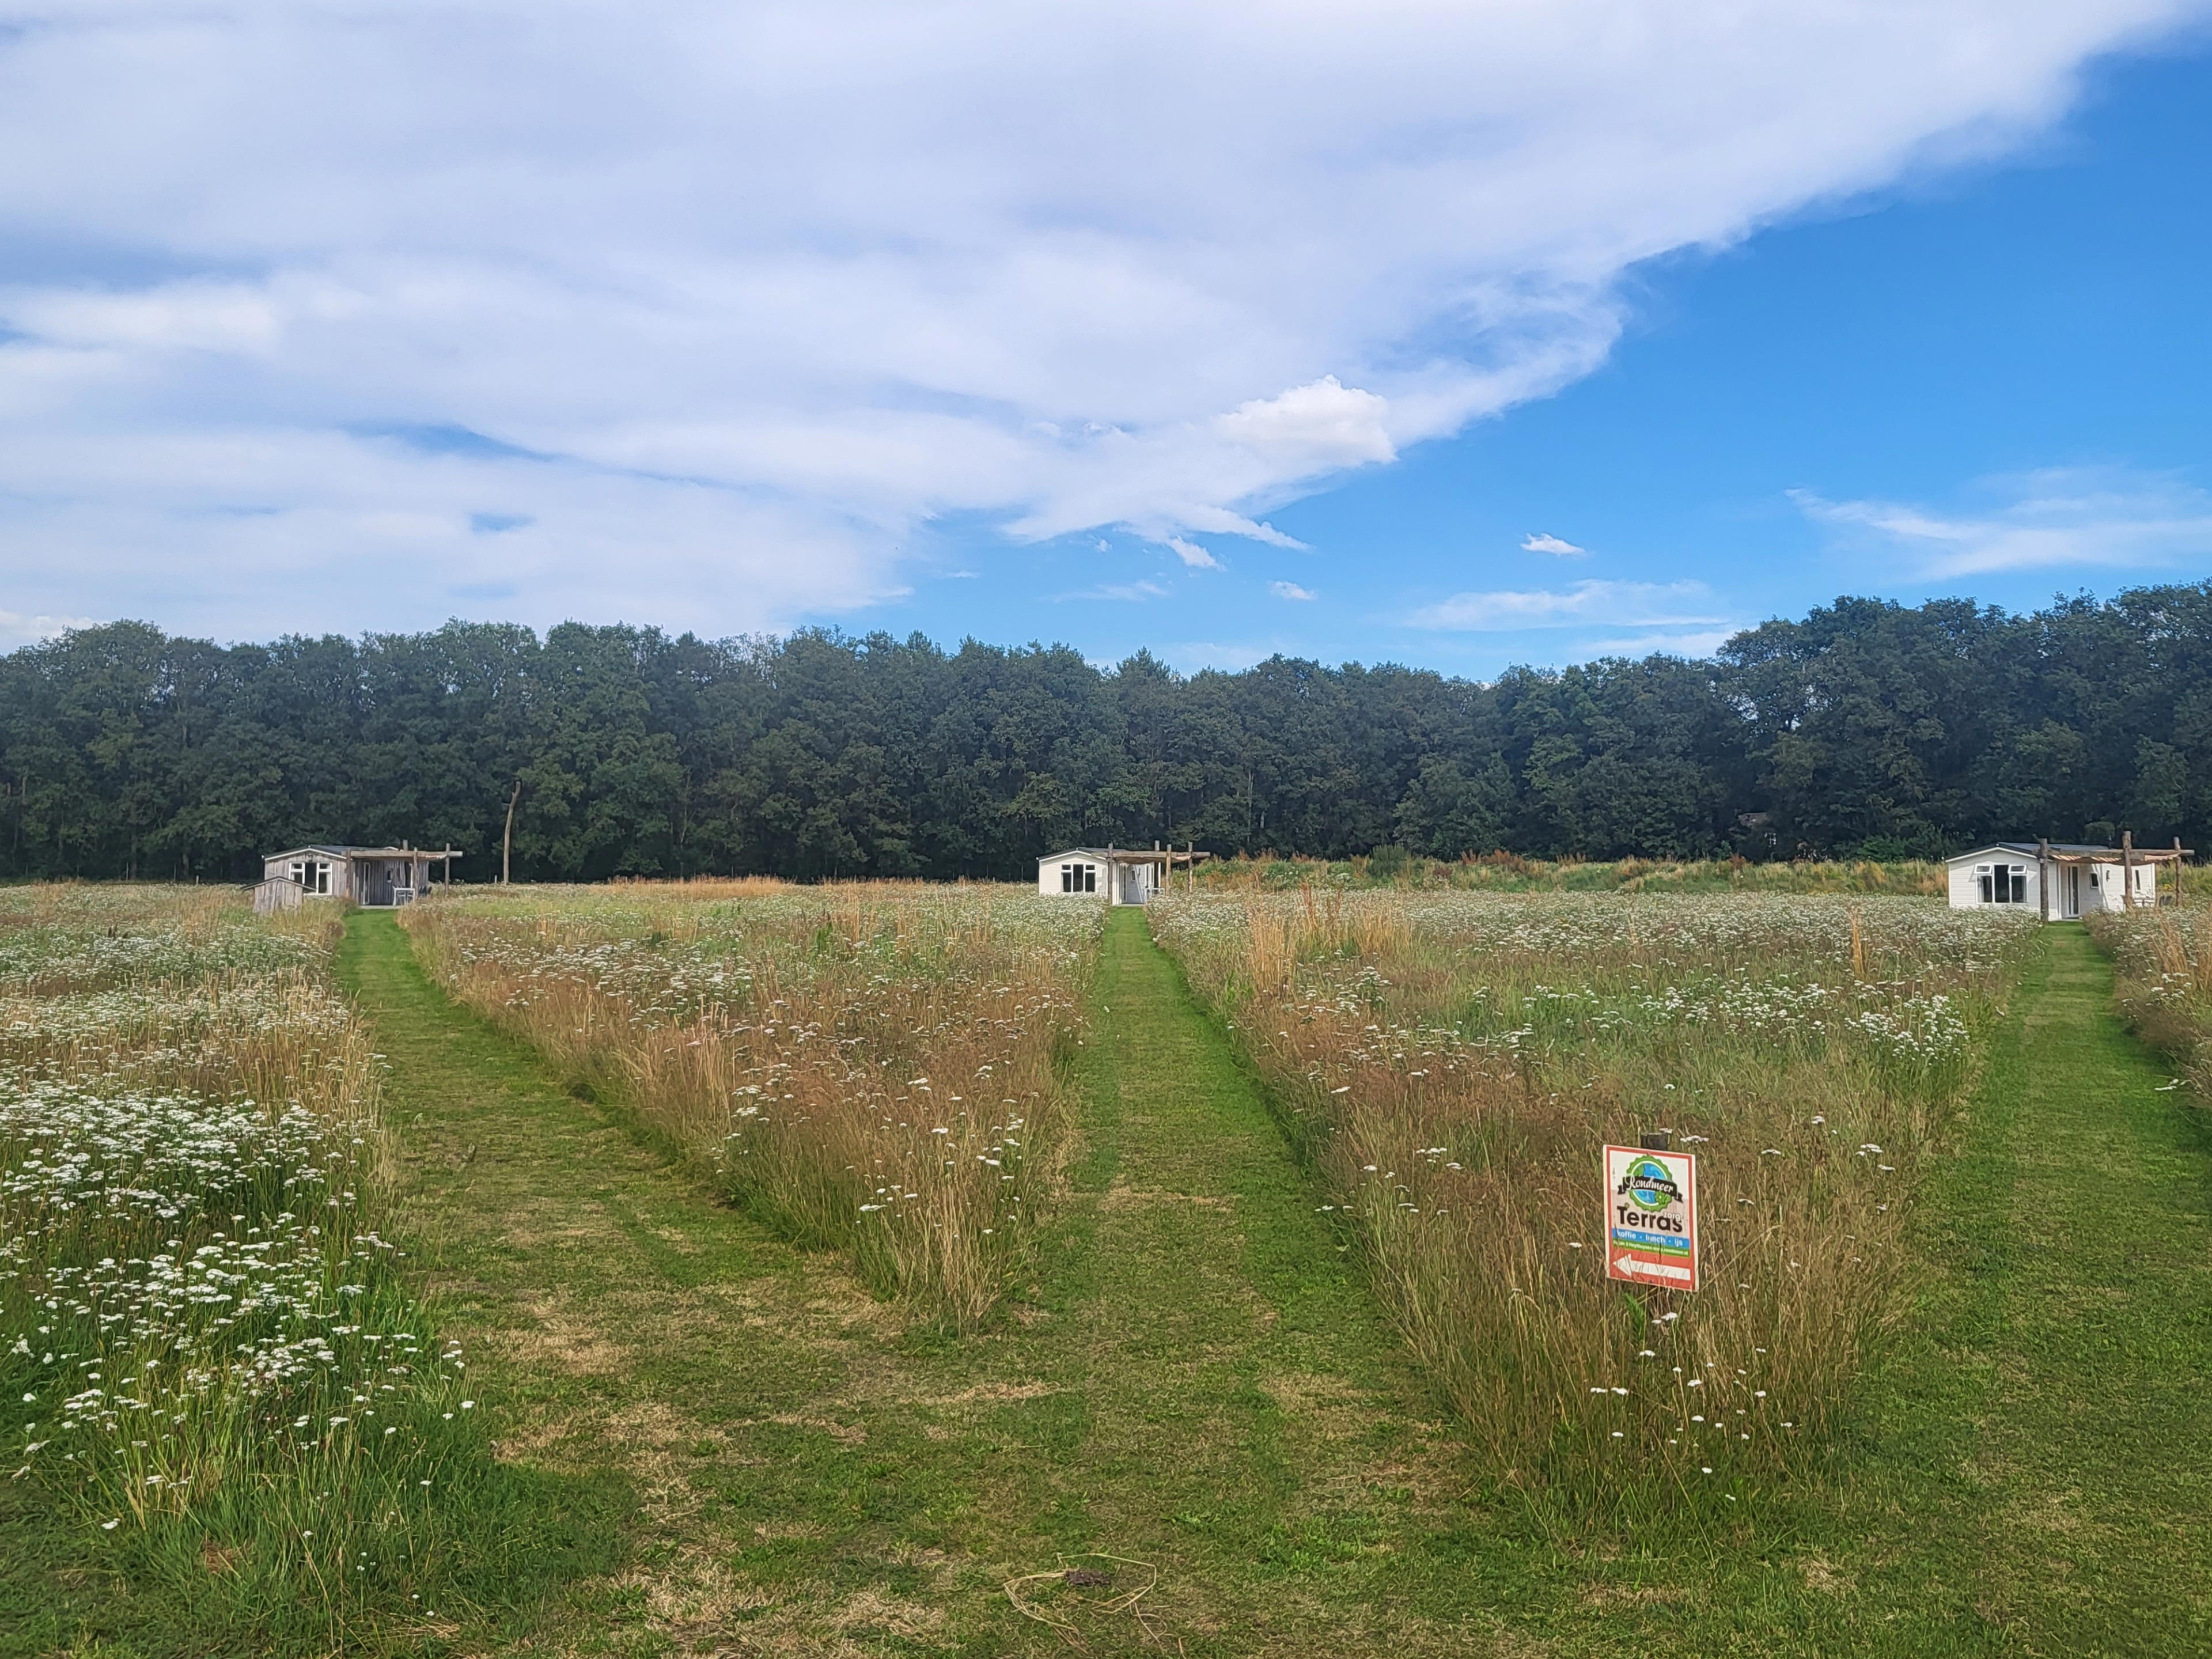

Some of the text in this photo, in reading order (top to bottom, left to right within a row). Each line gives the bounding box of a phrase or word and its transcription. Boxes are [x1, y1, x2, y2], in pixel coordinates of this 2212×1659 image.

[1624, 1174, 1673, 1192] Rondmeer
[1617, 1206, 1683, 1232] Terras
[1663, 1212, 1681, 1221] zorg
[1617, 1229, 1636, 1239] koffie
[1646, 1234, 1665, 1243] lunch
